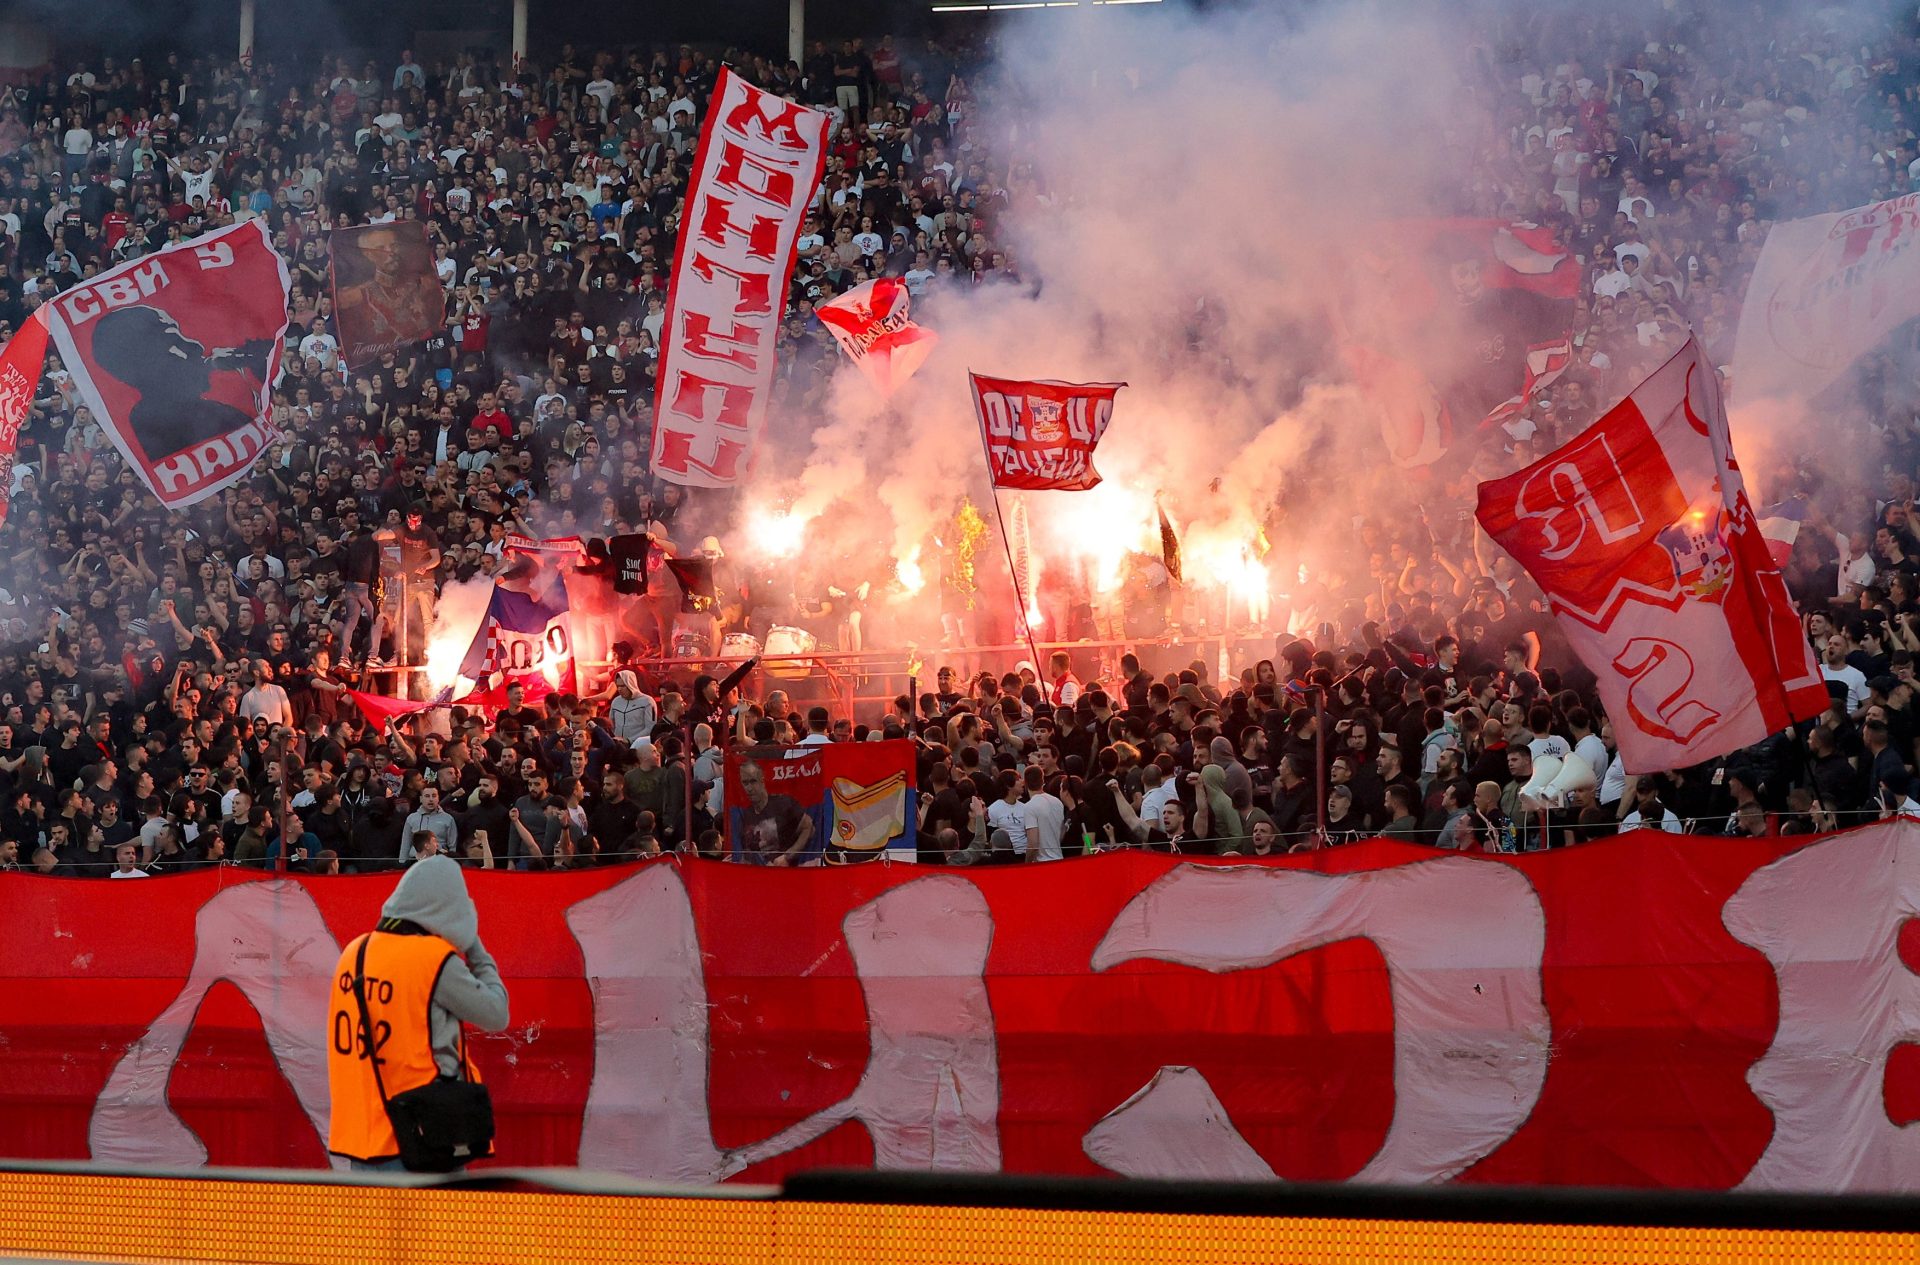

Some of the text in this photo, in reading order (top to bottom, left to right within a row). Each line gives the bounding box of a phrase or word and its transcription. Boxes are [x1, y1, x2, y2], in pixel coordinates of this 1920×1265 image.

[62, 241, 235, 326] СВИ У
[339, 970, 394, 1005] ФТО
[334, 1010, 392, 1066] 062
